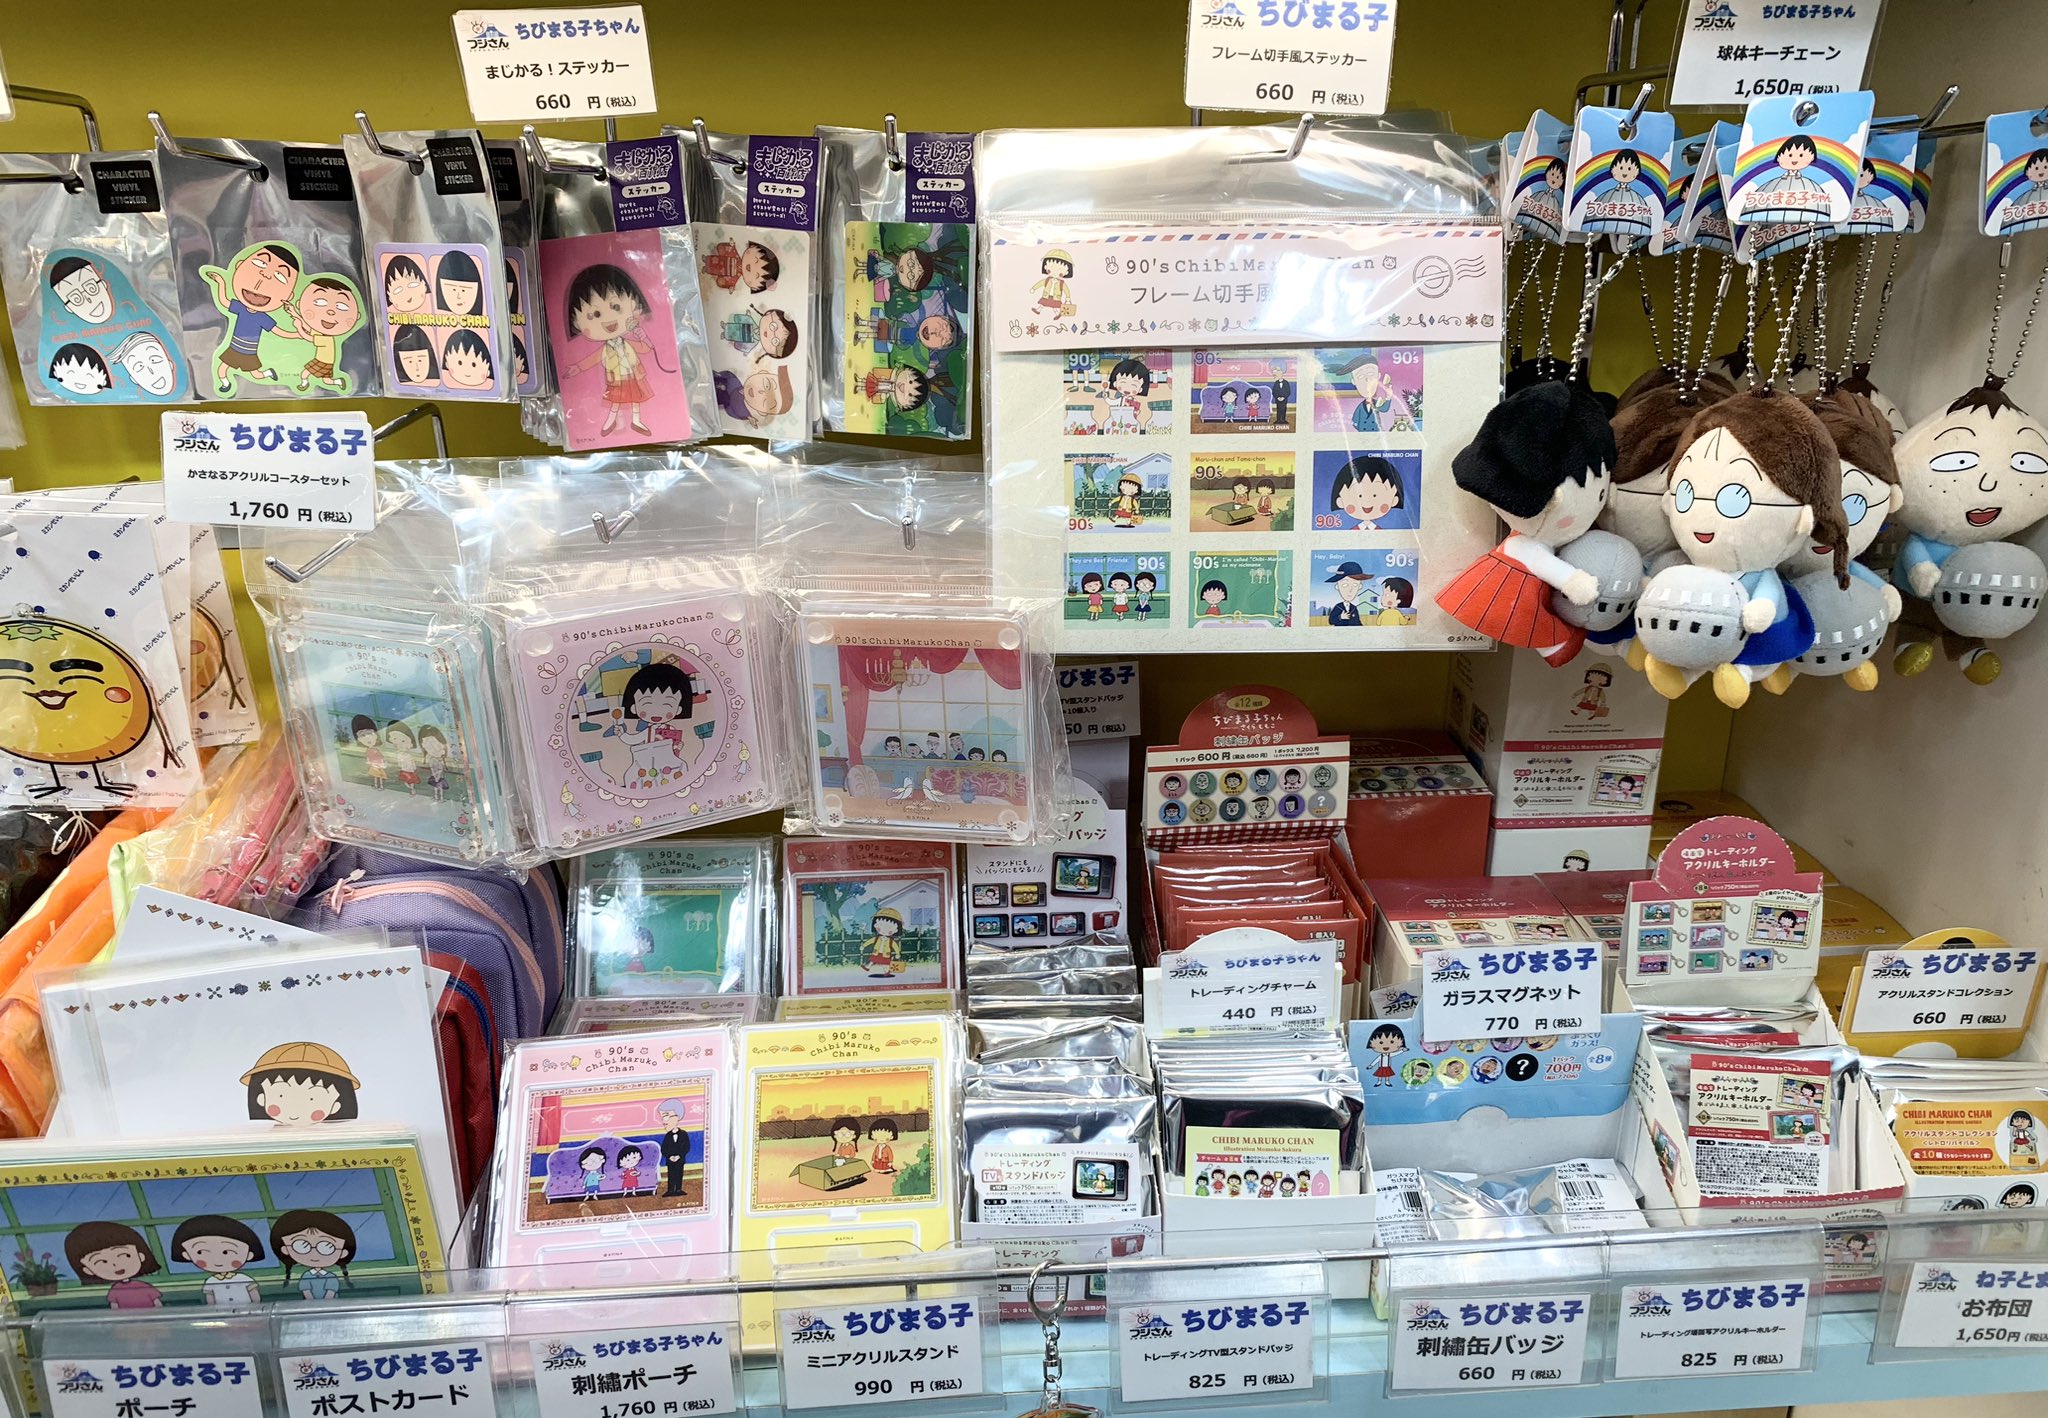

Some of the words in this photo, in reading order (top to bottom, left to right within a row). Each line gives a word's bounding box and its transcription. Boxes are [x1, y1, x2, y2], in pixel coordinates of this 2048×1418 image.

[1257, 0, 1389, 32] ちびまる子
[1763, 5, 1856, 18] ちびまる子ちゃん
[1201, 15, 1245, 28] フジさん
[1694, 17, 1735, 28] フジさん
[515, 18, 640, 39] ちびまる子ちゃん
[467, 38, 509, 49] フジさん
[1212, 47, 1367, 66] フレーム切手風ステッカー
[1717, 46, 1841, 60] 球体キーチェーン
[486, 59, 629, 79] まじかる！ステッカー
[1256, 83, 1293, 100] 660
[535, 94, 570, 110] 660
[432, 146, 473, 158] CHARACTER
[288, 156, 345, 166] CHARACTER
[445, 160, 467, 171] VINYL
[97, 169, 150, 180] CHARACTER
[305, 170, 333, 179] VINYL
[444, 173, 473, 184] STICKER
[112, 183, 140, 192] VINYL
[300, 182, 339, 192] STICKER
[628, 186, 665, 195] ステッカー
[764, 185, 800, 194] ステッカー
[111, 195, 148, 205] STICKER
[1744, 190, 1833, 207] ちびまる子ちゃん
[1585, 201, 1653, 218] ちびまる子ちゃん
[1126, 258, 1169, 274] 90's
[1174, 258, 1239, 273] Chibi
[460, 314, 490, 328] CHAN
[1069, 353, 1096, 366] 90's
[1195, 351, 1222, 365] 90's
[1392, 351, 1419, 364] 90's
[173, 438, 220, 451] フジさん
[230, 423, 367, 456] ちびまる子
[188, 469, 351, 486] かさなるアクリルコースターセット
[1195, 466, 1223, 479] 90's
[229, 501, 289, 520] 1,760
[1068, 518, 1093, 530] 90's
[1315, 514, 1343, 528] 90's
[1137, 557, 1165, 570] 90's
[1193, 556, 1219, 569] 90's
[1385, 553, 1415, 567] 90's
[572, 629, 598, 642] 90's
[598, 624, 633, 638] Chibi
[634, 619, 676, 632] Maruko
[676, 613, 704, 625] Chan
[845, 636, 869, 646] 90's
[870, 638, 902, 646] Chibi
[903, 638, 943, 647] Maruko
[943, 639, 971, 648] Chan
[1060, 666, 1135, 688] びまる子
[1212, 713, 1283, 726] ちびまる子ちゃん
[1514, 776, 1585, 784] アクリルキーホルダー
[659, 850, 683, 861] 90's
[1706, 846, 1758, 856] トレーディング
[659, 866, 683, 875] Chan
[669, 859, 702, 871] Maruko
[1683, 860, 1776, 870] アクリルキーホルダー
[1224, 954, 1321, 969] ちびまる子ちゃん
[1479, 948, 1598, 976] ちびまる子
[1922, 952, 2036, 975] ちびまる子
[1169, 969, 1208, 978] フジさん
[1431, 971, 1470, 981] フジさん
[1873, 968, 1911, 977] フジさん
[1191, 980, 1316, 998] トレーディングチャーム
[1878, 988, 2014, 999] アクリルスタンドコレクション
[1443, 984, 1581, 1008] ガラスマグネット
[1222, 1007, 1255, 1019] 440
[1913, 1012, 1946, 1025] 660
[1485, 1016, 1518, 1031] 770
[832, 1031, 858, 1041] 90's
[608, 1045, 635, 1056] 90's
[810, 1042, 841, 1057] Chibi
[843, 1042, 881, 1053] Maruko
[832, 1049, 859, 1059] Chan
[585, 1058, 616, 1073] Chibi
[620, 1055, 658, 1068] Maruko
[608, 1064, 636, 1074] Chan
[1544, 1063, 1582, 1073] 700円
[1698, 1093, 1773, 1102] アクリルキーホルダー
[1903, 1110, 1926, 1119] CHIBI
[1929, 1110, 1965, 1119] MARUKO
[1968, 1110, 1992, 1118] CHAN
[1242, 1137, 1285, 1145] MARUKO
[1918, 1282, 1957, 1290] フジさん
[1682, 1284, 1805, 1312] ちびまる子
[1460, 1300, 1584, 1326] ちびまる子
[1629, 1306, 1671, 1315] フジさん
[1962, 1298, 2033, 1317] お布団
[844, 1303, 973, 1336] ちびまる子
[1182, 1302, 1309, 1333] ちびまる子
[1407, 1319, 1448, 1329] フジさん
[792, 1331, 835, 1341] フジさん
[1130, 1327, 1173, 1338] フジさん
[1640, 1326, 1786, 1339] トレーディング場面写アクリルキーホルダー
[593, 1331, 723, 1358] ちびまる子ちゃん
[1416, 1334, 1564, 1357] 刺繍缶バッジ
[807, 1344, 959, 1369] ミニアクリルスタンド
[1144, 1344, 1294, 1362] トレーディングTV型スタンドバッジ
[347, 1348, 482, 1382] ちびまる子
[543, 1357, 586, 1369] フジさん
[1681, 1353, 1717, 1367] 825
[111, 1362, 250, 1389] ちびまる子
[572, 1364, 697, 1396] 刺繍ポーチ
[1458, 1367, 1495, 1380] 660
[57, 1382, 103, 1393] フジさん
[293, 1377, 339, 1388] フジさん
[854, 1379, 893, 1395] 990
[1189, 1374, 1226, 1389] 825
[311, 1384, 469, 1417] ポストカード
[116, 1397, 197, 1418] ポーチ
[601, 1401, 656, 1418] 1,760
